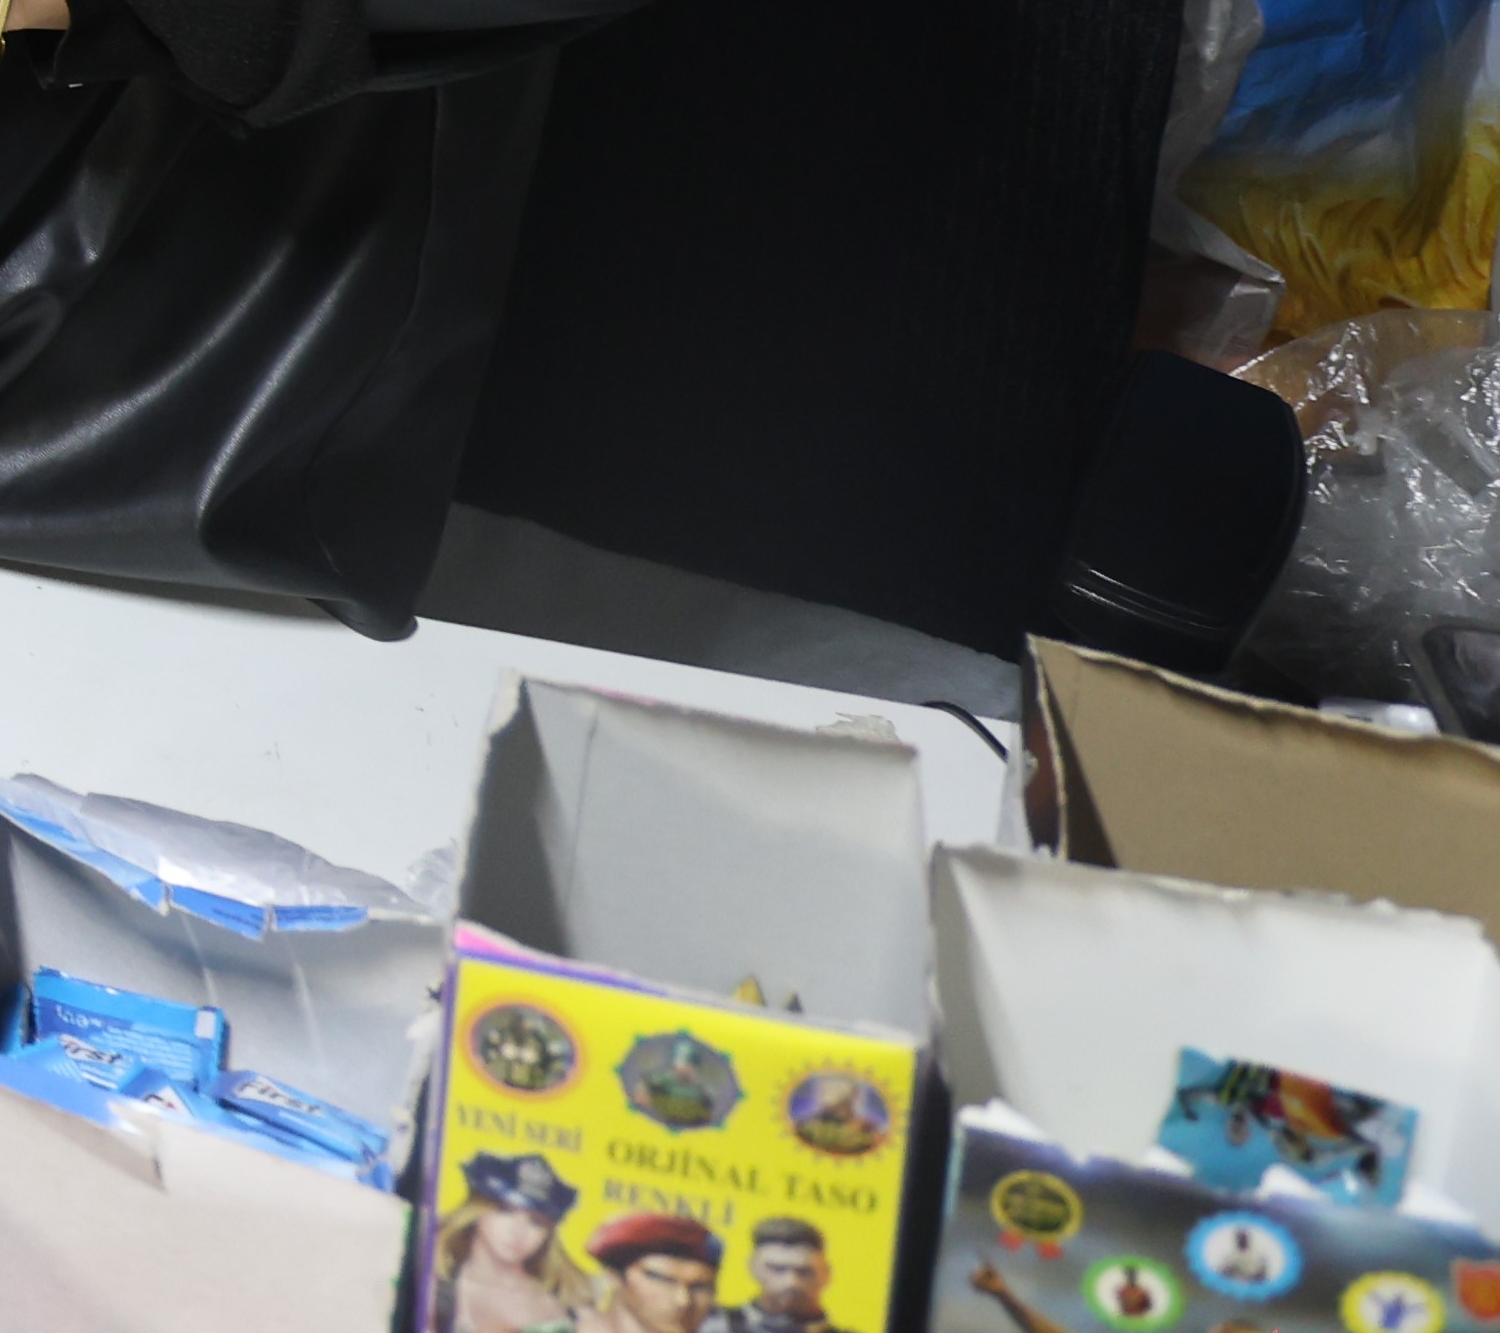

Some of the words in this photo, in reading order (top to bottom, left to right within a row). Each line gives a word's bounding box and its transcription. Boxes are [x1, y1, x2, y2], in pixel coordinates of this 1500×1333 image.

[456, 1103, 521, 1141] YENİ
[522, 1116, 584, 1155] SERİ
[606, 1138, 770, 1197] ORJİNAL
[782, 1173, 880, 1215] TASO
